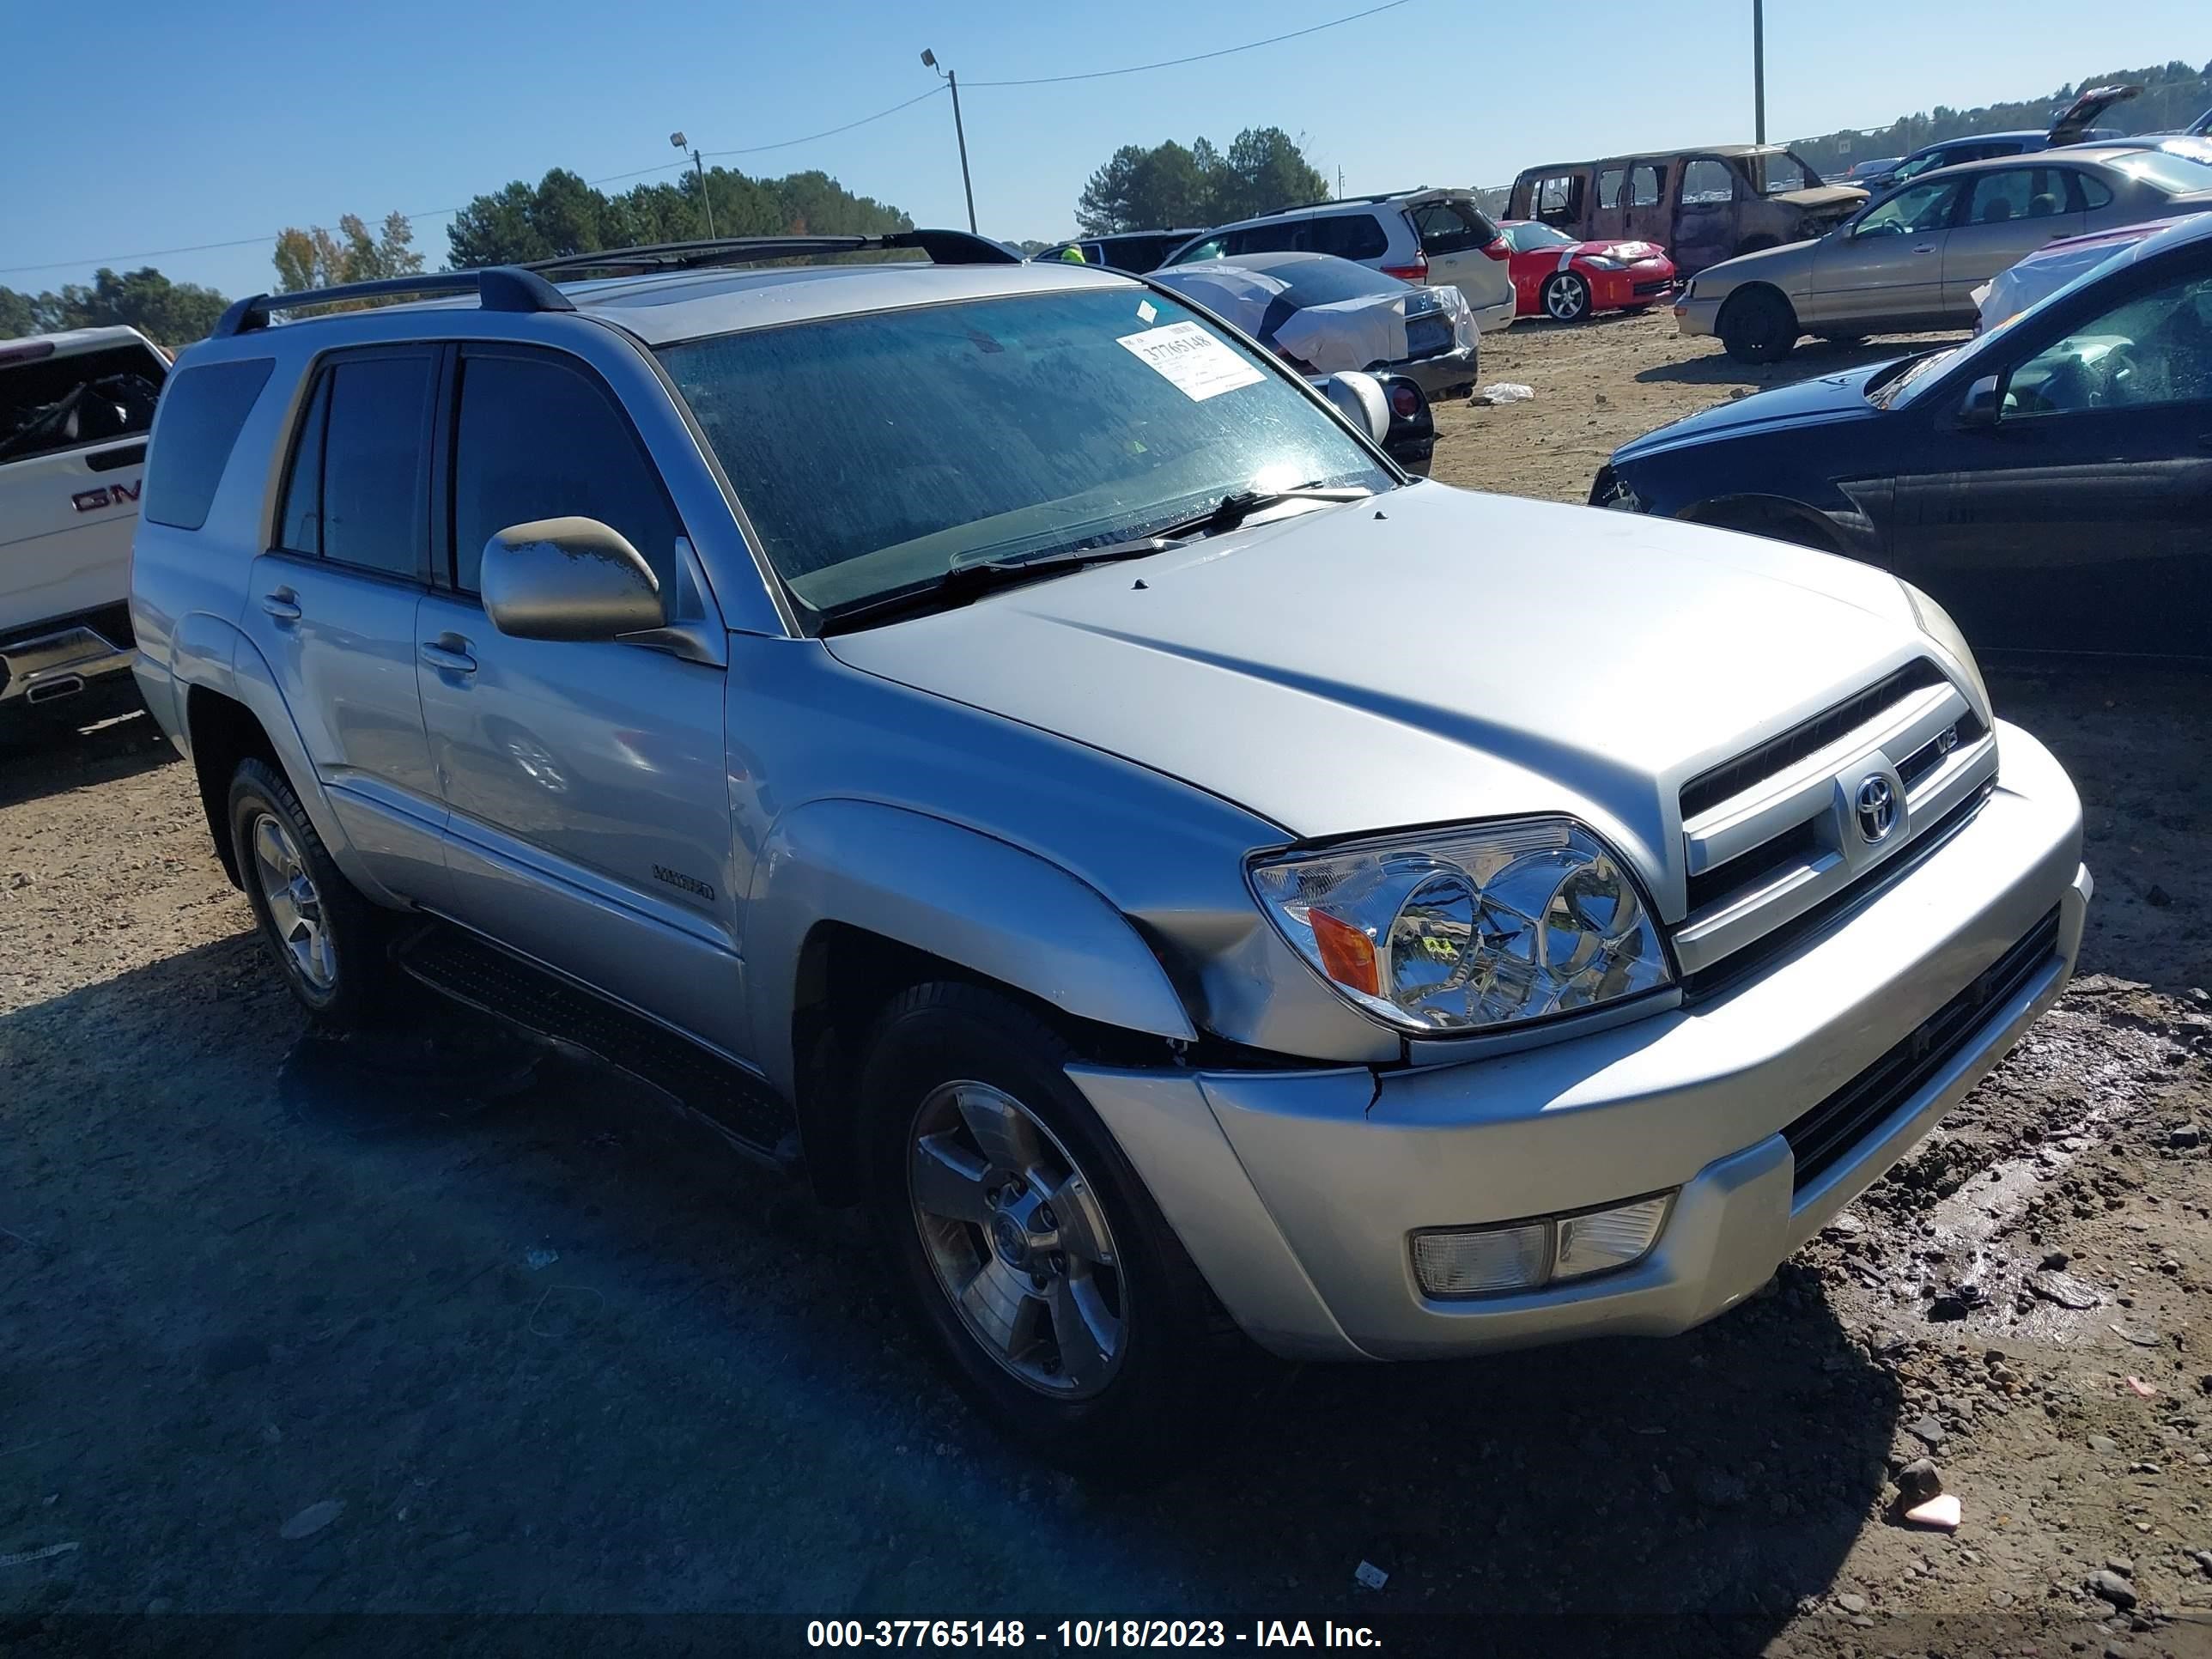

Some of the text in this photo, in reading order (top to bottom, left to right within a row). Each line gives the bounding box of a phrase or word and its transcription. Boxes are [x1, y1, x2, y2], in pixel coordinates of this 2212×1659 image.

[1143, 335, 1212, 361] 37765148
[72, 479, 142, 513] GM
[1936, 723, 1958, 755] V6
